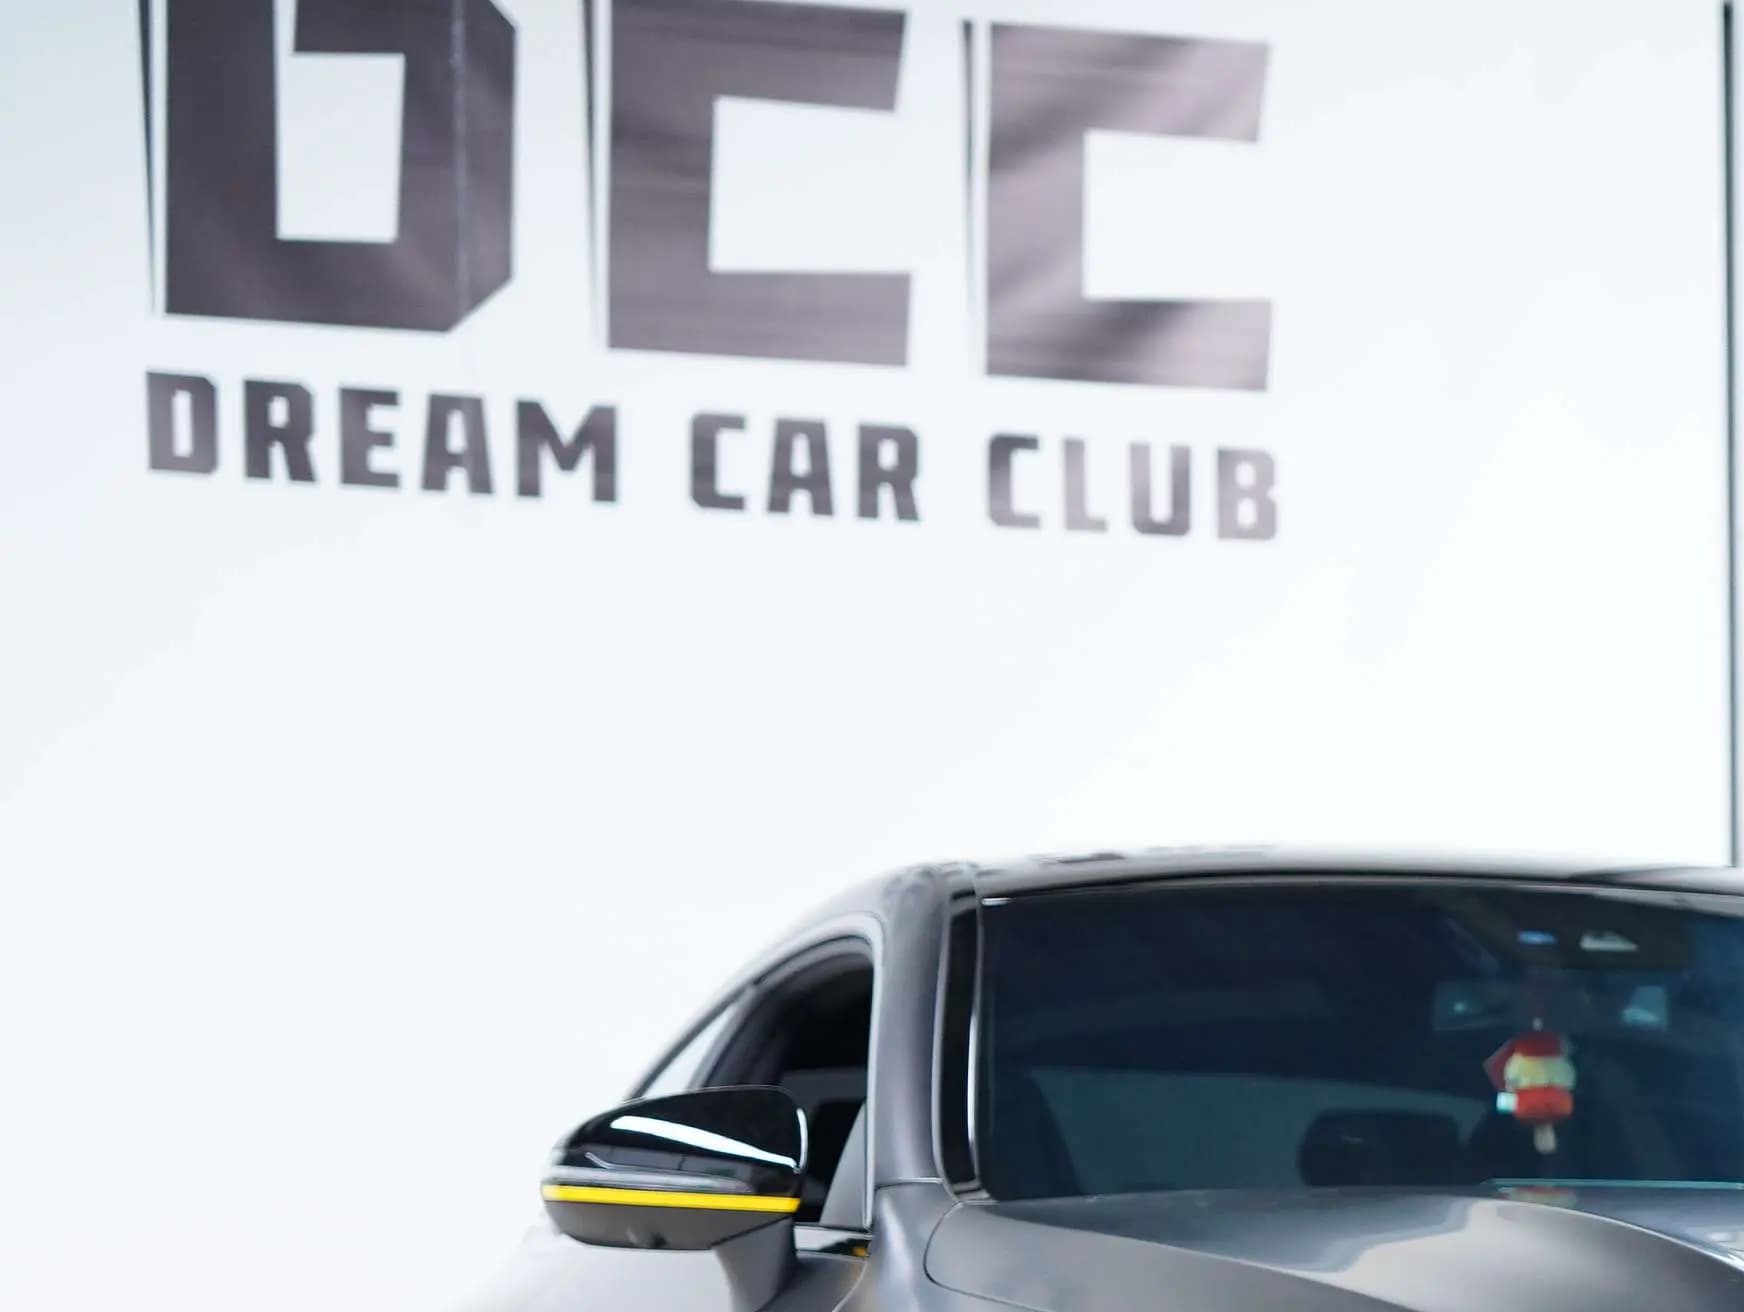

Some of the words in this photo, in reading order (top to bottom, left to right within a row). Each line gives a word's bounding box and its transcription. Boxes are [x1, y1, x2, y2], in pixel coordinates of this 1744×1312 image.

[146, 370, 619, 505] DREAM
[689, 411, 921, 523] CAR
[986, 432, 1278, 542] CLUB
